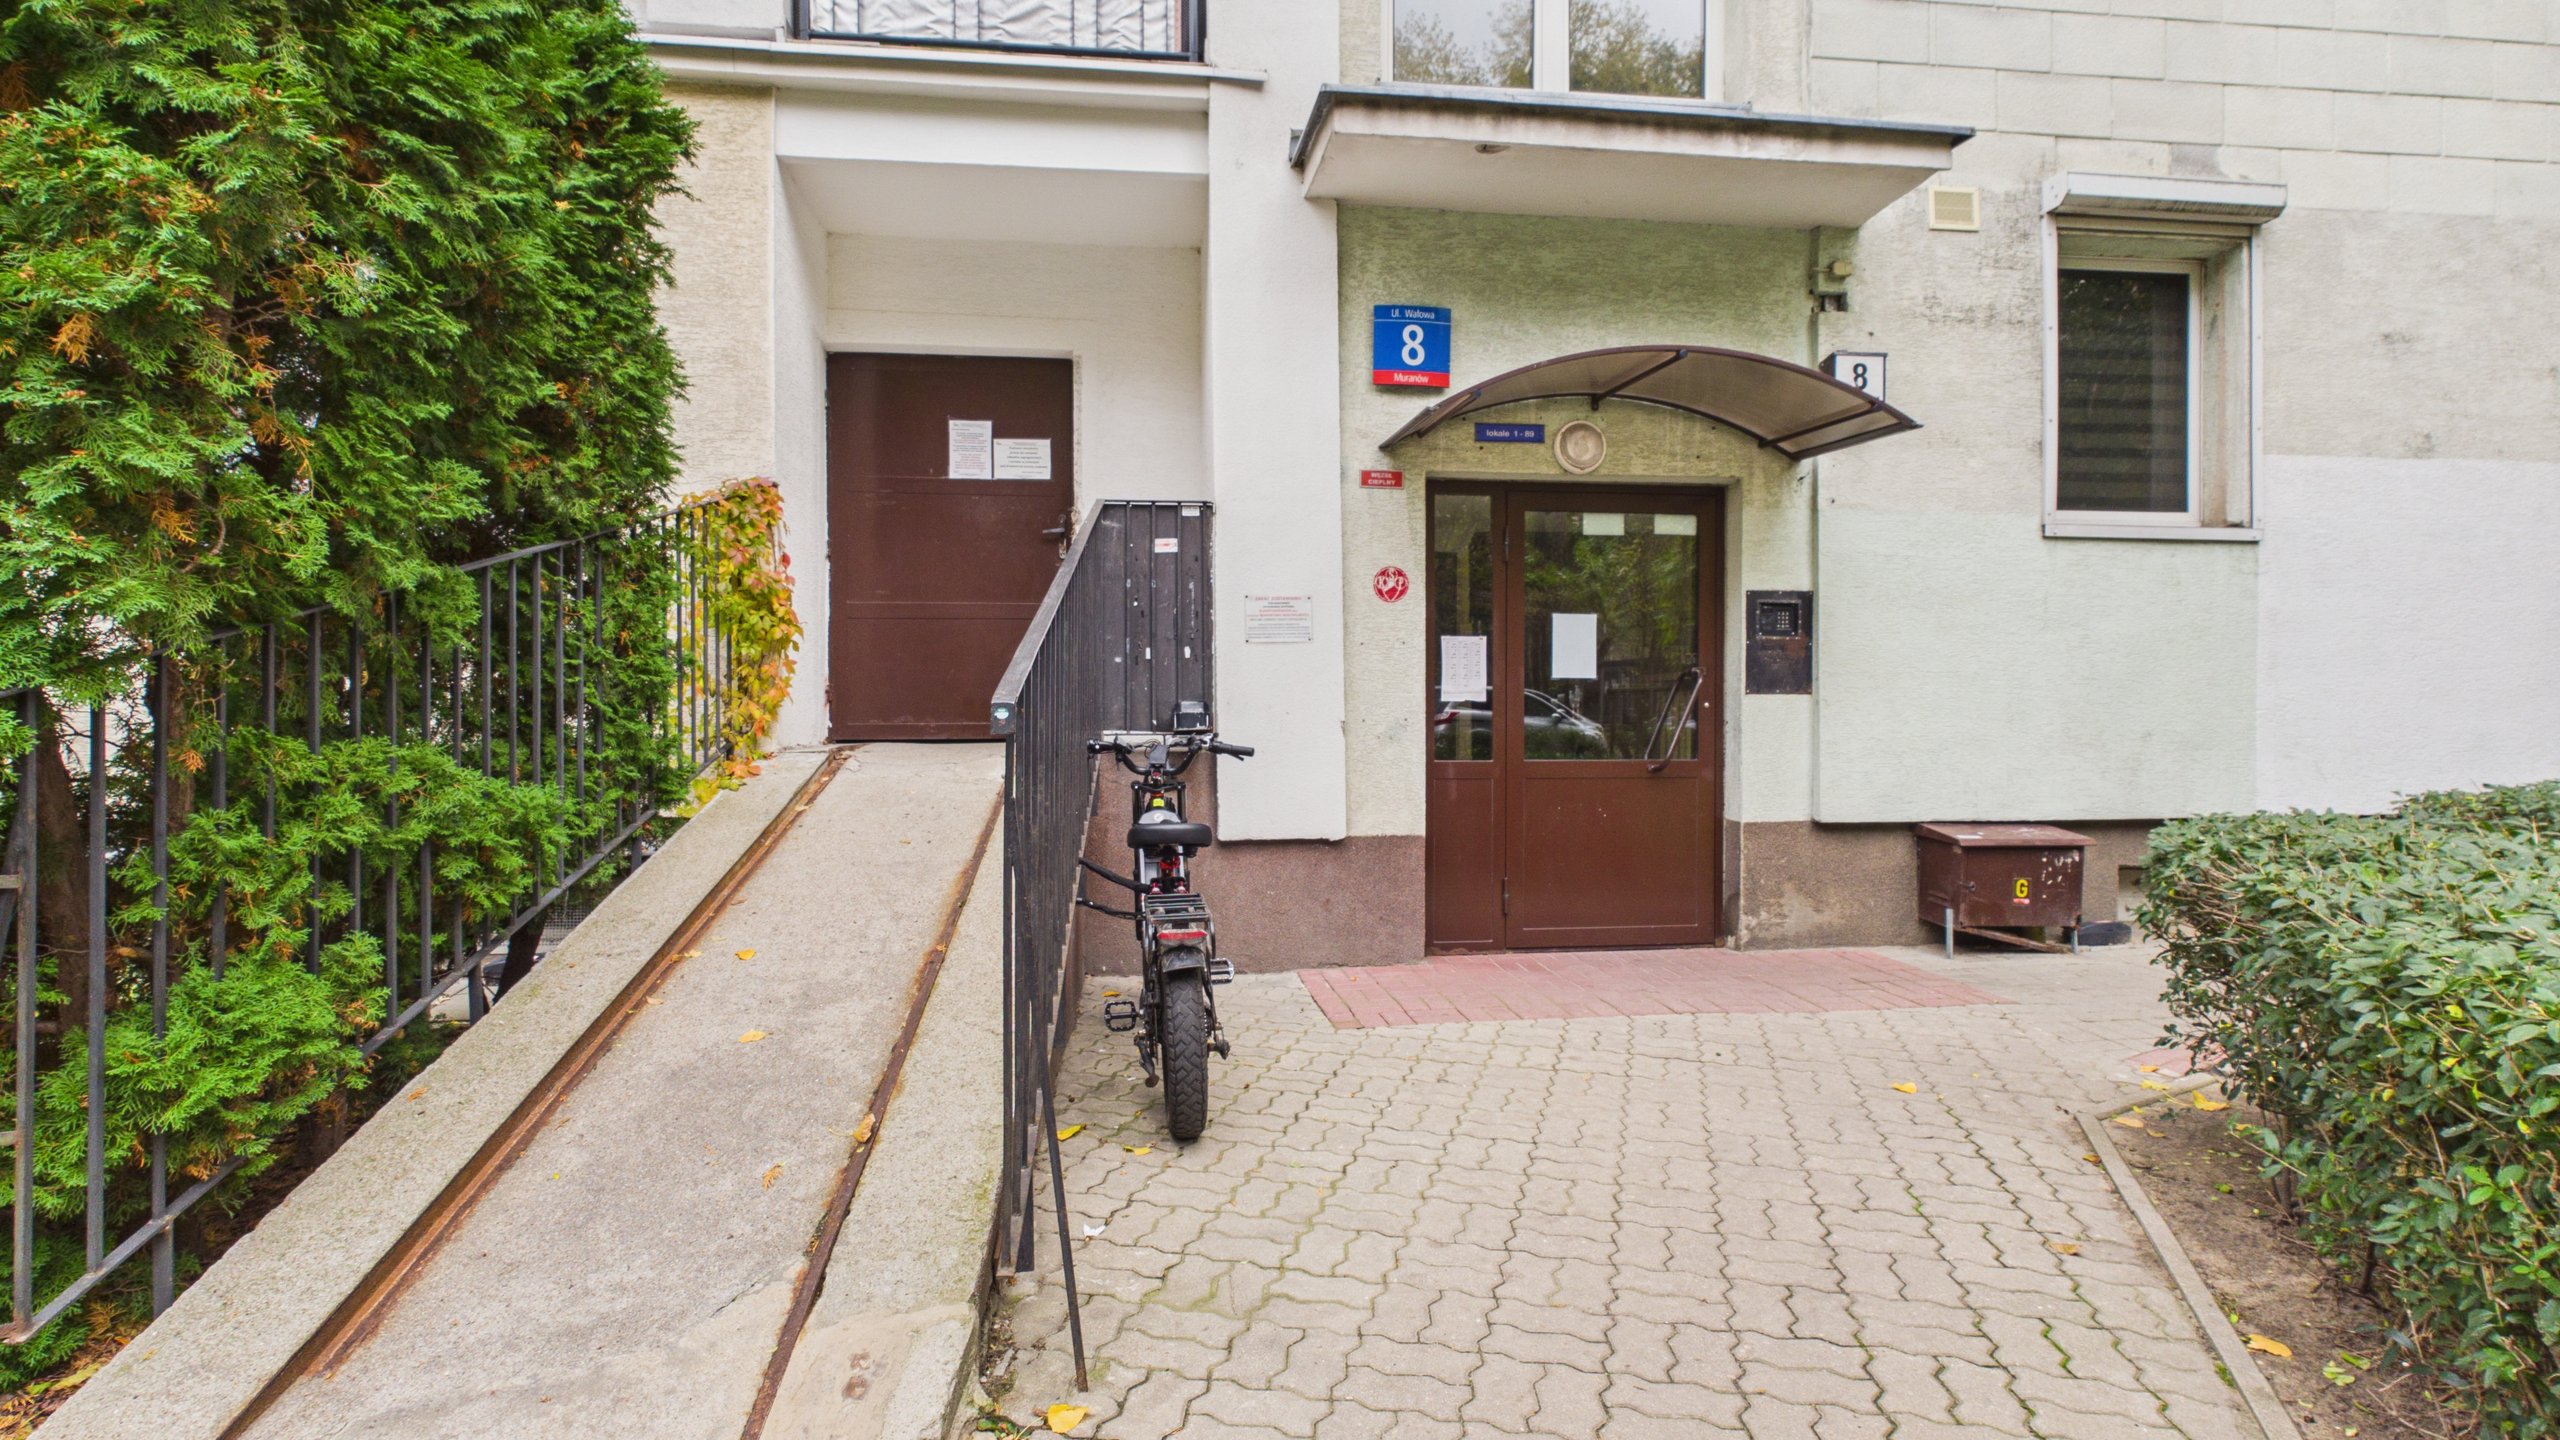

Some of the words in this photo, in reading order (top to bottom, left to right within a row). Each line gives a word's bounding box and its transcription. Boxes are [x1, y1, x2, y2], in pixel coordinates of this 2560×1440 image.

[1401, 324, 1425, 366] 8
[1393, 372, 1429, 383] Muranów
[1853, 363, 1868, 390] 8
[2016, 879, 2028, 898] G
